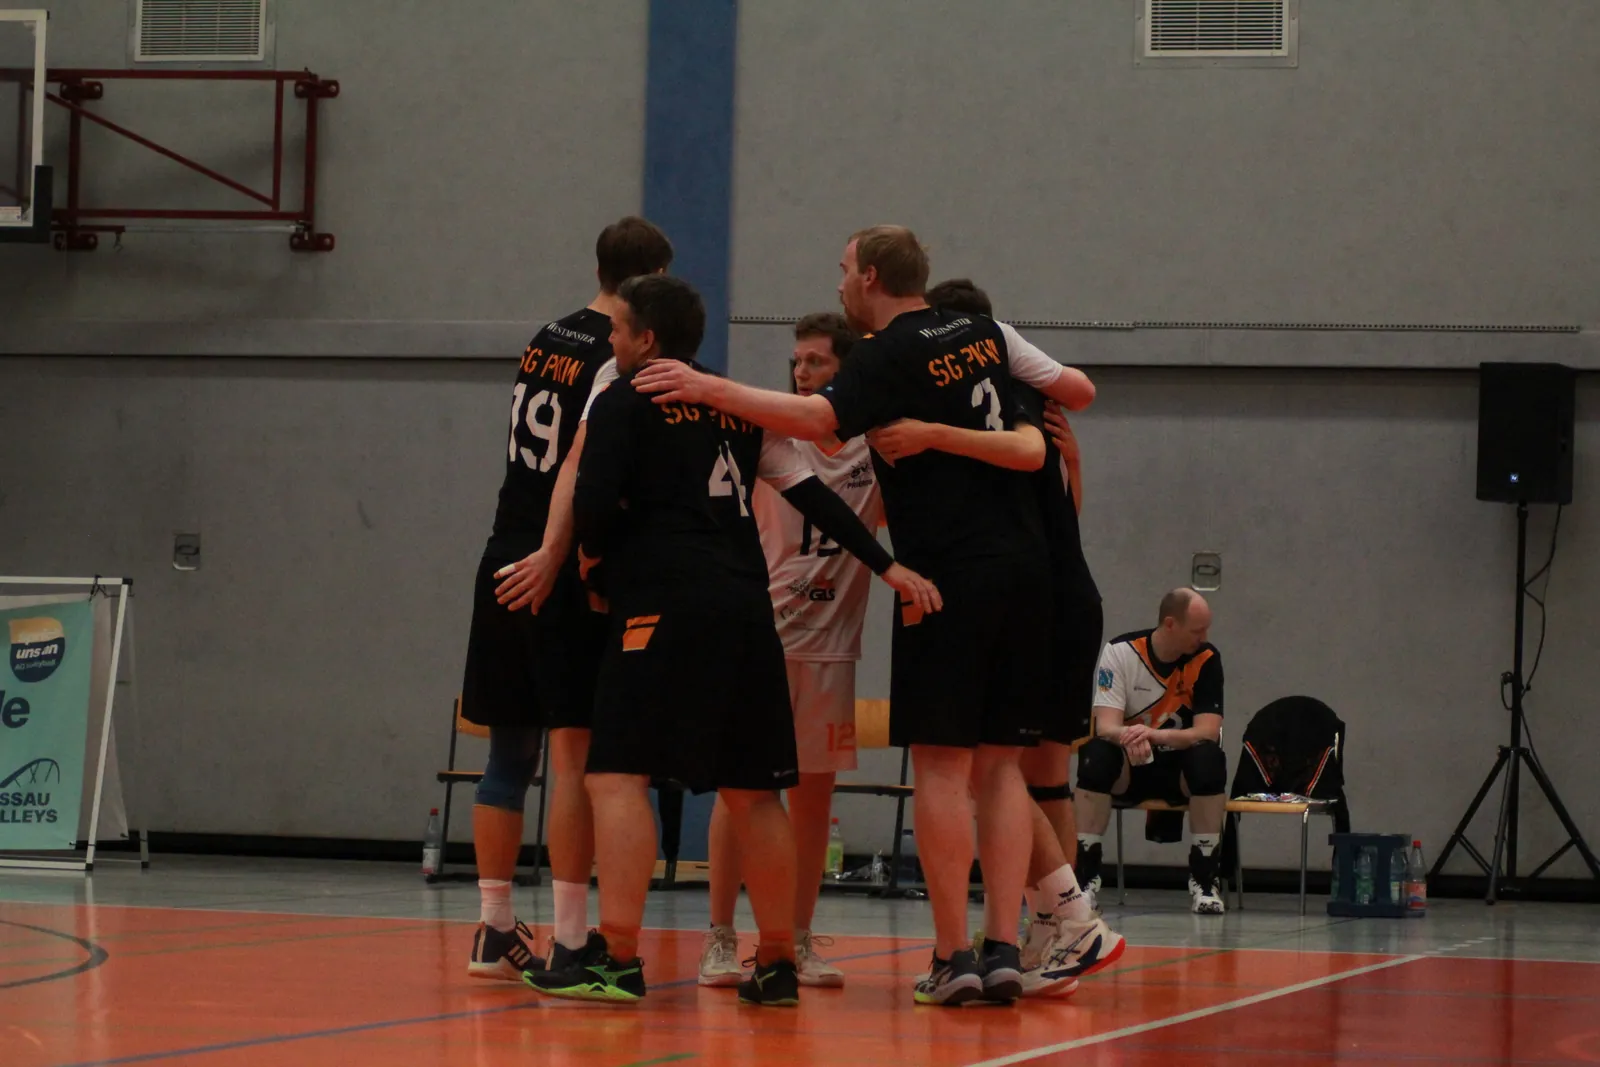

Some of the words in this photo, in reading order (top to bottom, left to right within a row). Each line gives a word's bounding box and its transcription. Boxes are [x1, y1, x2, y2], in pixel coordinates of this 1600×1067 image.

[540, 353, 585, 387] PKW
[928, 353, 963, 387] SG
[959, 338, 1001, 374] PKW
[508, 382, 562, 473] 19
[708, 440, 750, 517] 4
[16, 647, 42, 660] uns
[826, 720, 856, 752] 12
[0, 809, 58, 823] LLEYS
